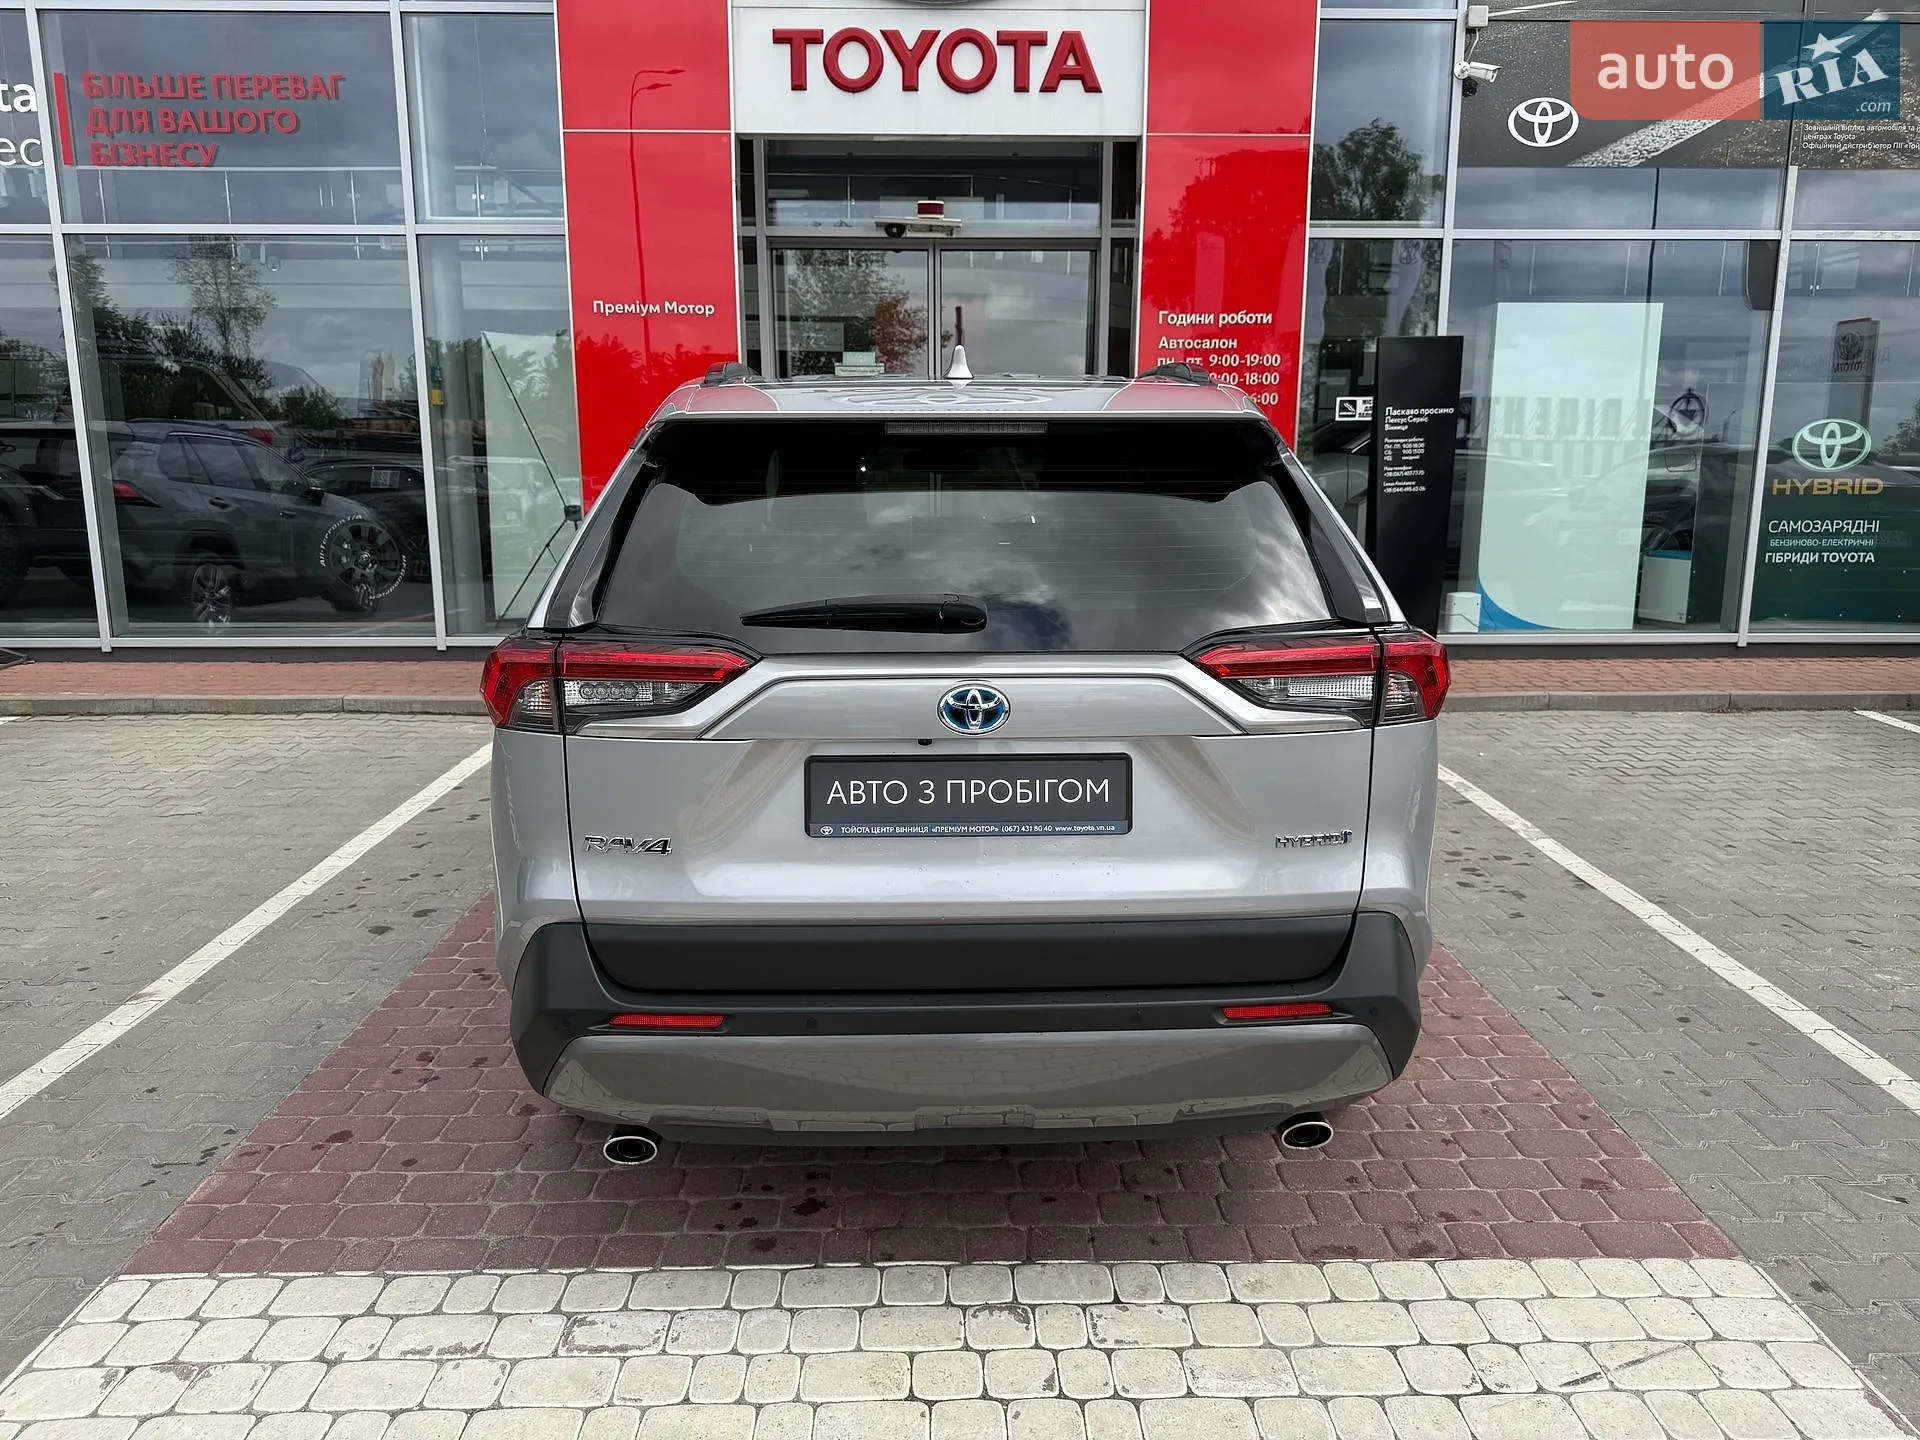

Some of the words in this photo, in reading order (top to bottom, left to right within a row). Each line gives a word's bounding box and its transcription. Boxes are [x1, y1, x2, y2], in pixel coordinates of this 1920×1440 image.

[772, 27, 1102, 94] TOYOTA
[81, 72, 206, 99] БІЛЬШЕ
[212, 73, 346, 100] ПЕРЕВАГ
[86, 107, 150, 137] ДЛЯ
[158, 107, 299, 134] ВАШОГО
[90, 142, 218, 168] БІЗНЕСУ
[592, 300, 661, 317] Преміум
[664, 301, 715, 317] Мотор
[1158, 311, 1214, 326] Години
[1218, 310, 1273, 327] роботи
[1158, 336, 1238, 349] Автосалон
[1385, 406, 1419, 416] Ласкаво
[1420, 407, 1455, 416] просимо
[1772, 478, 1884, 495] HYBRID
[1768, 520, 1880, 534] САМОЗАРЯДНІ
[1770, 538, 1874, 547] БЕНЗИНОВО-ЕЛЕКТРИЧНІ
[1764, 552, 1819, 564] ГІБРИДИ
[1821, 552, 1876, 563] TOYOTA
[826, 780, 908, 805] АВТО
[947, 778, 1111, 804] ПРОБІГОМ
[841, 824, 870, 834] ТОЙОТА
[871, 826, 895, 835] ЦЕНТР
[896, 826, 929, 835] ВІННИЦЯ
[1001, 824, 1020, 833] (067)
[1021, 824, 1033, 832] 431
[1033, 824, 1043, 832] 80
[1043, 824, 1053, 832] 40
[1054, 824, 1115, 833] www.toyota.vn.ua
[584, 835, 672, 856] RAV4
